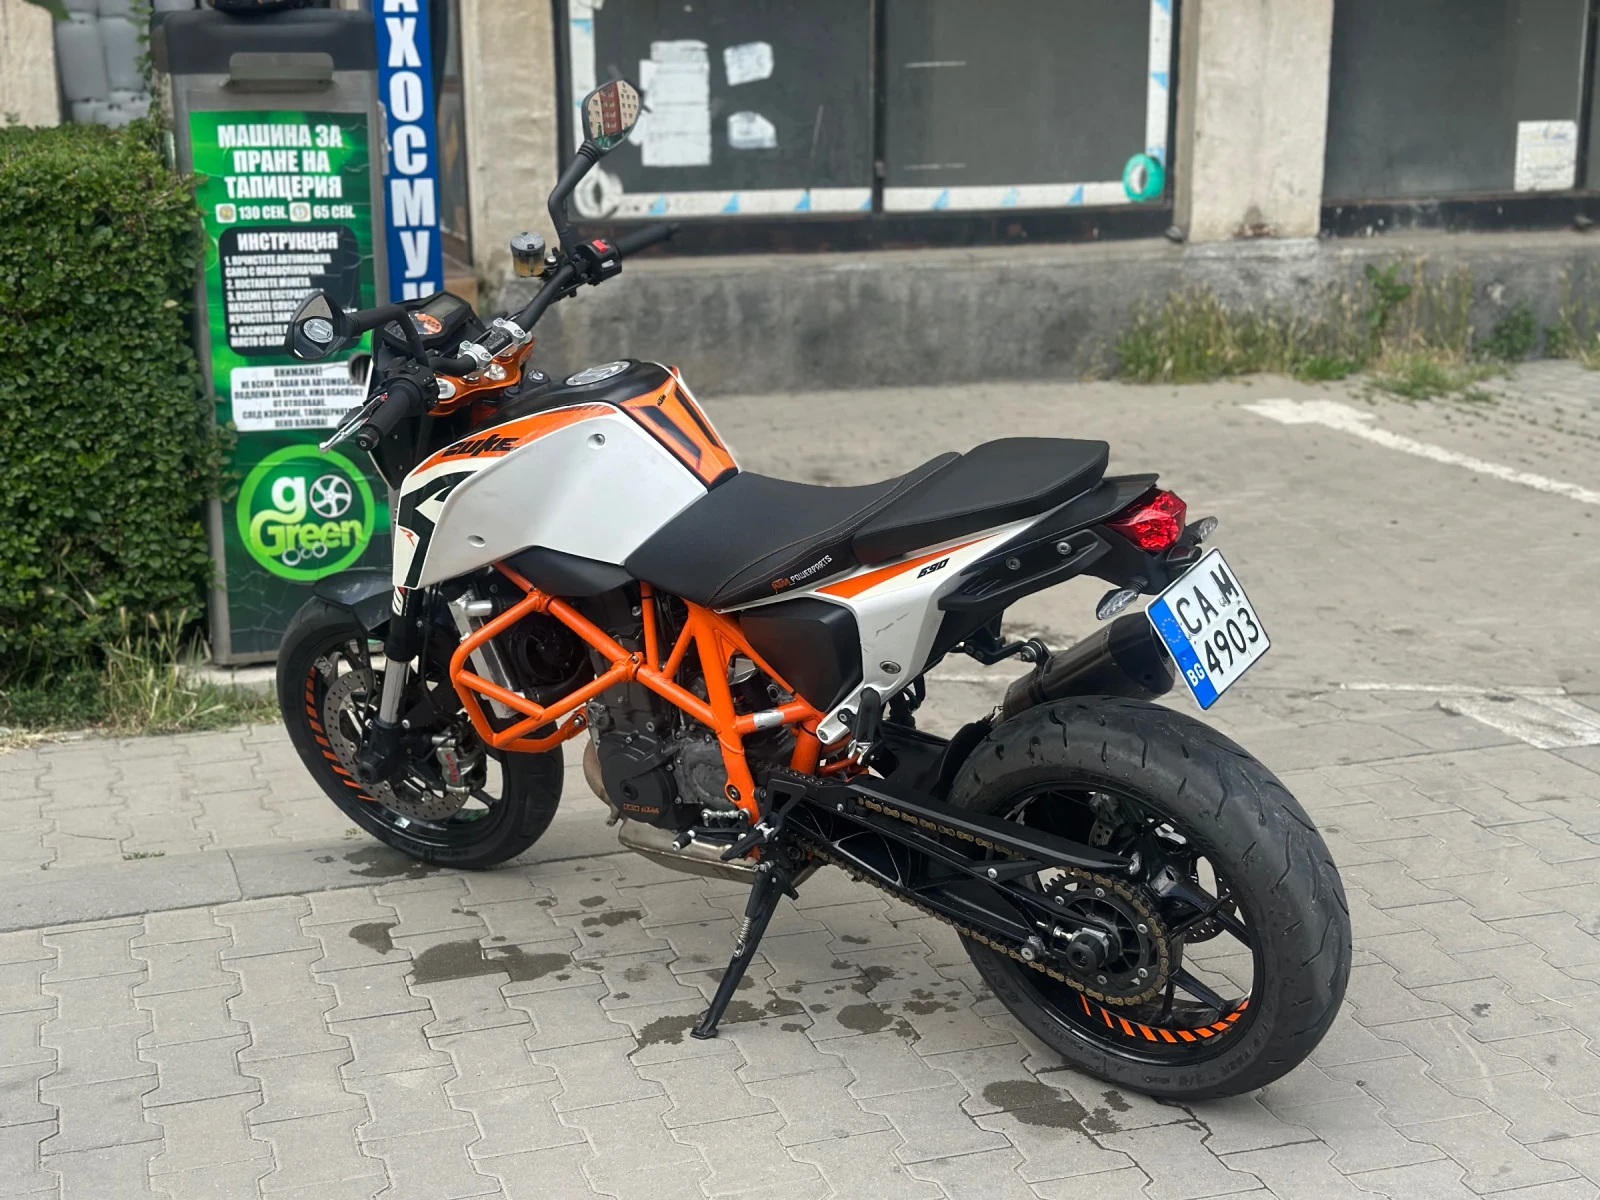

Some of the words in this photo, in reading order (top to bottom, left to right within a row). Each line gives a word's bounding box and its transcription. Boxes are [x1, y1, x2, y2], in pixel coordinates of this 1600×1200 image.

[217, 124, 312, 148] МАШИНА
[315, 124, 343, 148] ЗА
[232, 150, 299, 173] ПРАНЕ
[302, 150, 331, 173] НА
[383, 0, 436, 300] ХОСМУ
[224, 175, 342, 201] ТАПИЦЕРИЯ
[238, 206, 260, 220] 130
[262, 205, 288, 219] СЕК.
[313, 205, 330, 219] 65
[237, 232, 338, 252] ИНСТРУКЦИЯ
[274, 367, 322, 377] ВНИМАНИЕ!
[249, 510, 363, 556] Green
[916, 557, 950, 579] 690
[1204, 608, 1259, 675] 4903
[1186, 663, 1205, 687] BG
